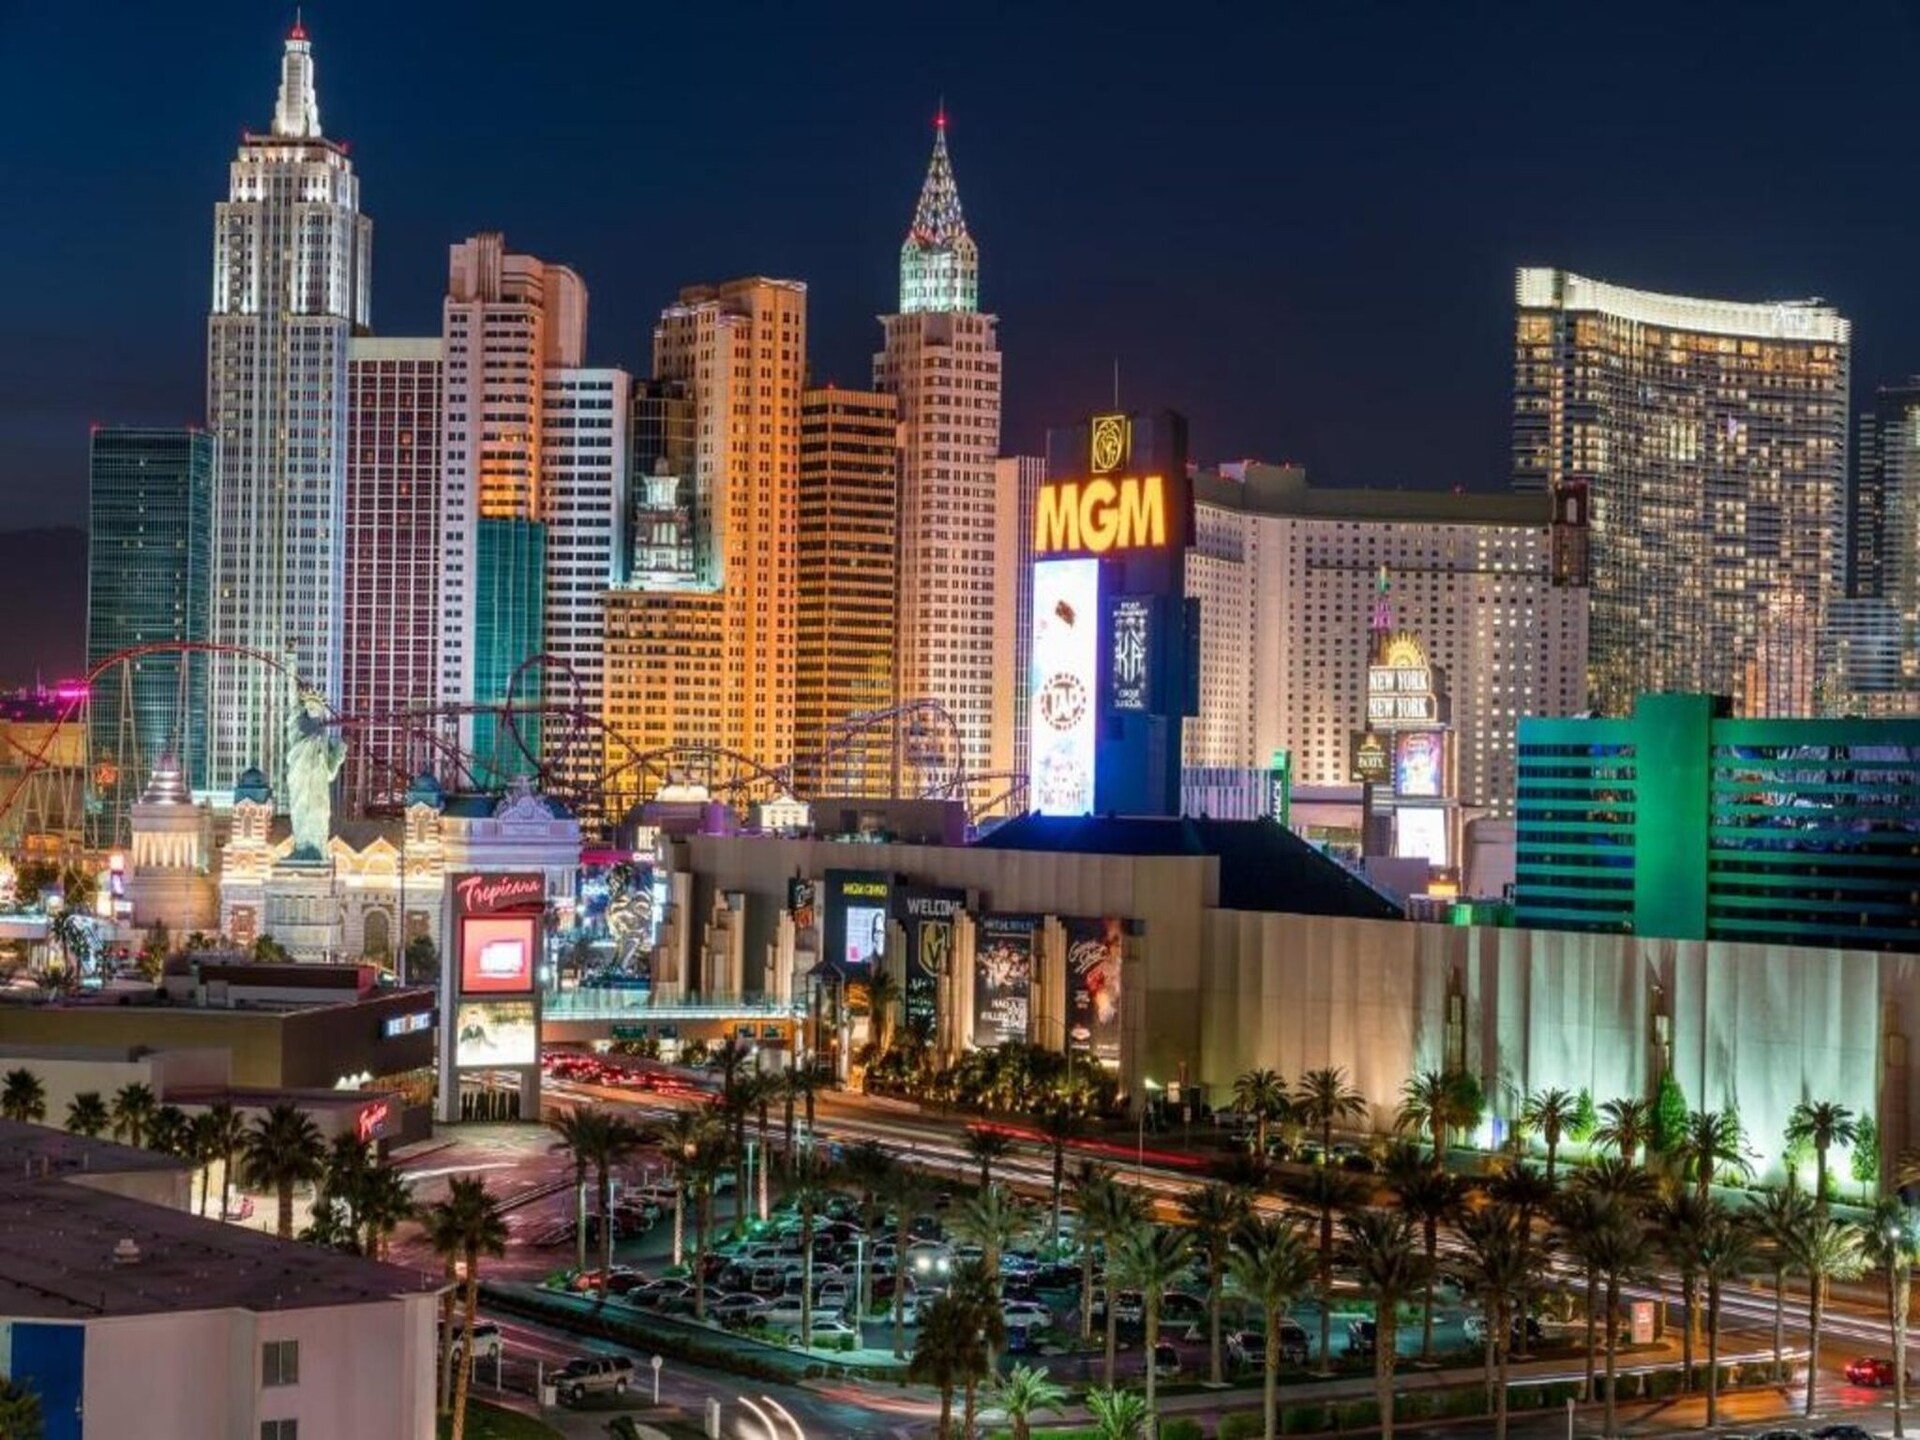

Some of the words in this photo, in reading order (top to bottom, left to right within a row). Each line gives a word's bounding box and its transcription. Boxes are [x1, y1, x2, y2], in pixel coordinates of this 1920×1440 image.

[1035, 476, 1165, 552] MGM
[1369, 670, 1395, 691] NEW
[1397, 670, 1428, 691] YORK
[1369, 697, 1395, 718] NEW
[1397, 697, 1428, 718] YORK
[457, 876, 540, 911] Tropicana
